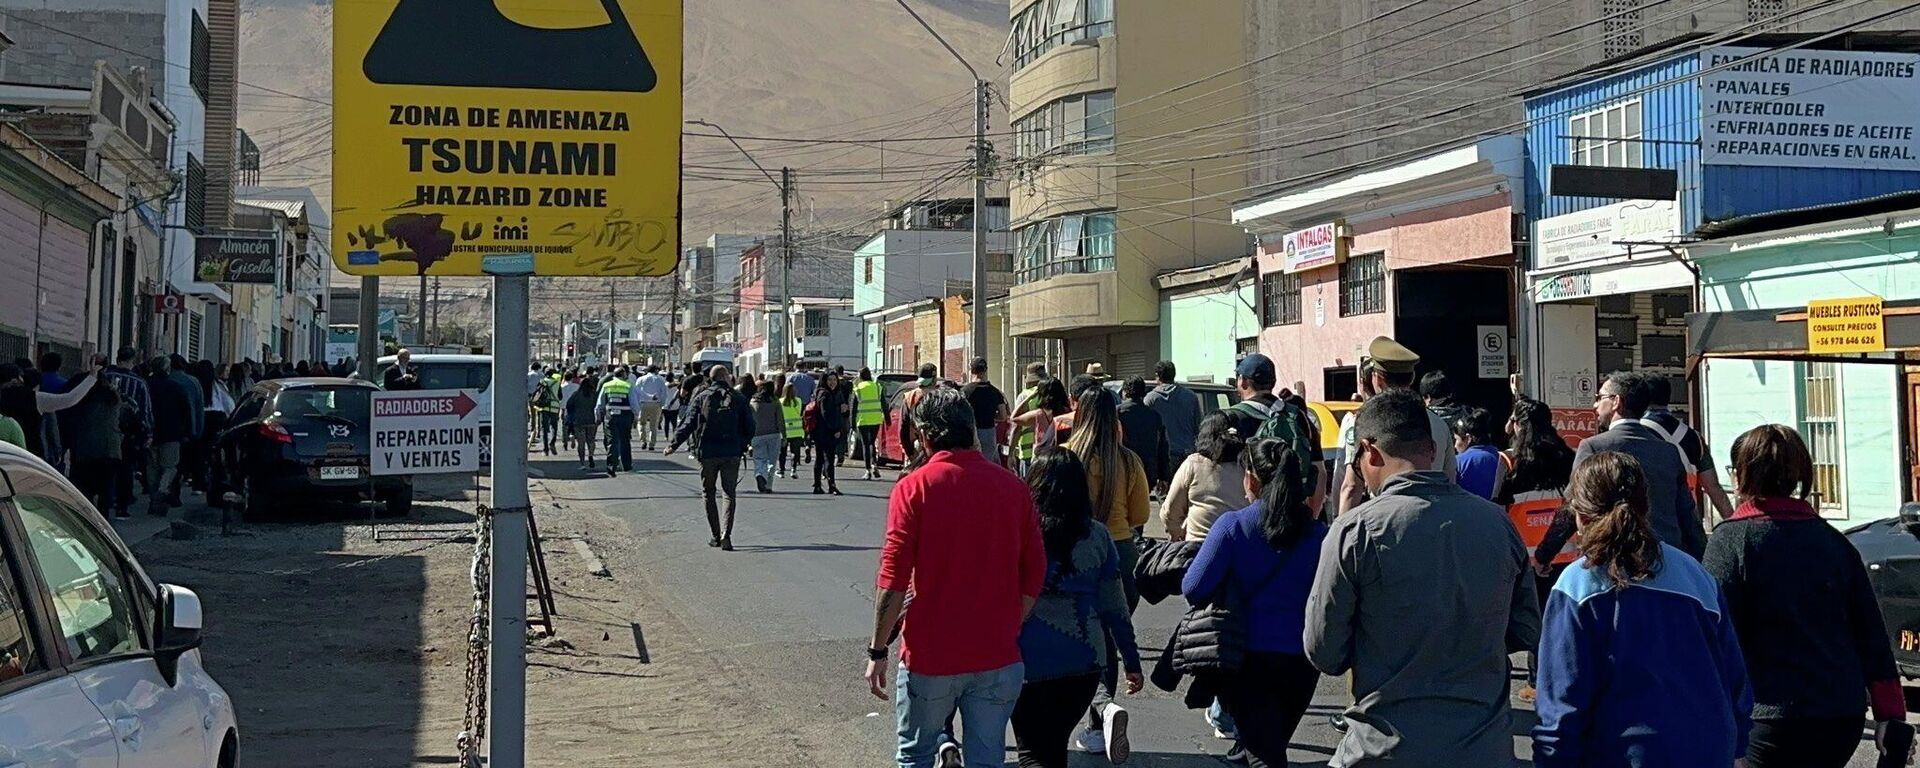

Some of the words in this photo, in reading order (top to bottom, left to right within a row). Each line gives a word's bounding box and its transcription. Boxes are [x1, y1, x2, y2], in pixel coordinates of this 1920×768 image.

[1711, 54, 1780, 74] FABRICA
[1785, 57, 1806, 74] DE
[1810, 58, 1915, 78] RADIADORES
[1715, 80, 1790, 96] PANALES
[389, 105, 461, 127] ZONA
[467, 107, 500, 128] DE
[506, 108, 630, 132] AMENAZA
[1716, 100, 1825, 117] INTERCOOLER
[1716, 120, 1830, 137] ENFRIADORES
[1833, 124, 1854, 138] DE
[1858, 125, 1914, 140] ACEITE
[401, 137, 616, 177] TSUNAMI
[1716, 141, 1840, 158] REPARACIONES
[1844, 144, 1864, 159] EN
[1868, 145, 1916, 161] GRAL.
[415, 184, 531, 206] HAZARD
[538, 187, 607, 208] ZONE
[219, 238, 270, 254] Almacén
[1296, 224, 1333, 250] INTALGAS
[478, 244, 533, 253] MUNICIPALIDAD
[534, 245, 543, 253] DE
[544, 245, 573, 254] IQUIQUE
[228, 258, 274, 281] Gisella
[1809, 305, 1841, 319] MUEBLES
[1843, 303, 1881, 317] RUSTICOS
[1813, 323, 1846, 332] CONSULTE
[1847, 322, 1877, 331] PRECIOS
[1816, 337, 1829, 346] +56
[1831, 337, 1844, 345] 978
[1861, 336, 1875, 344] 626
[376, 398, 454, 415] RADIADORES
[376, 427, 474, 448] REPARACION
[384, 451, 393, 469] Y
[401, 449, 461, 468] VENTAS
